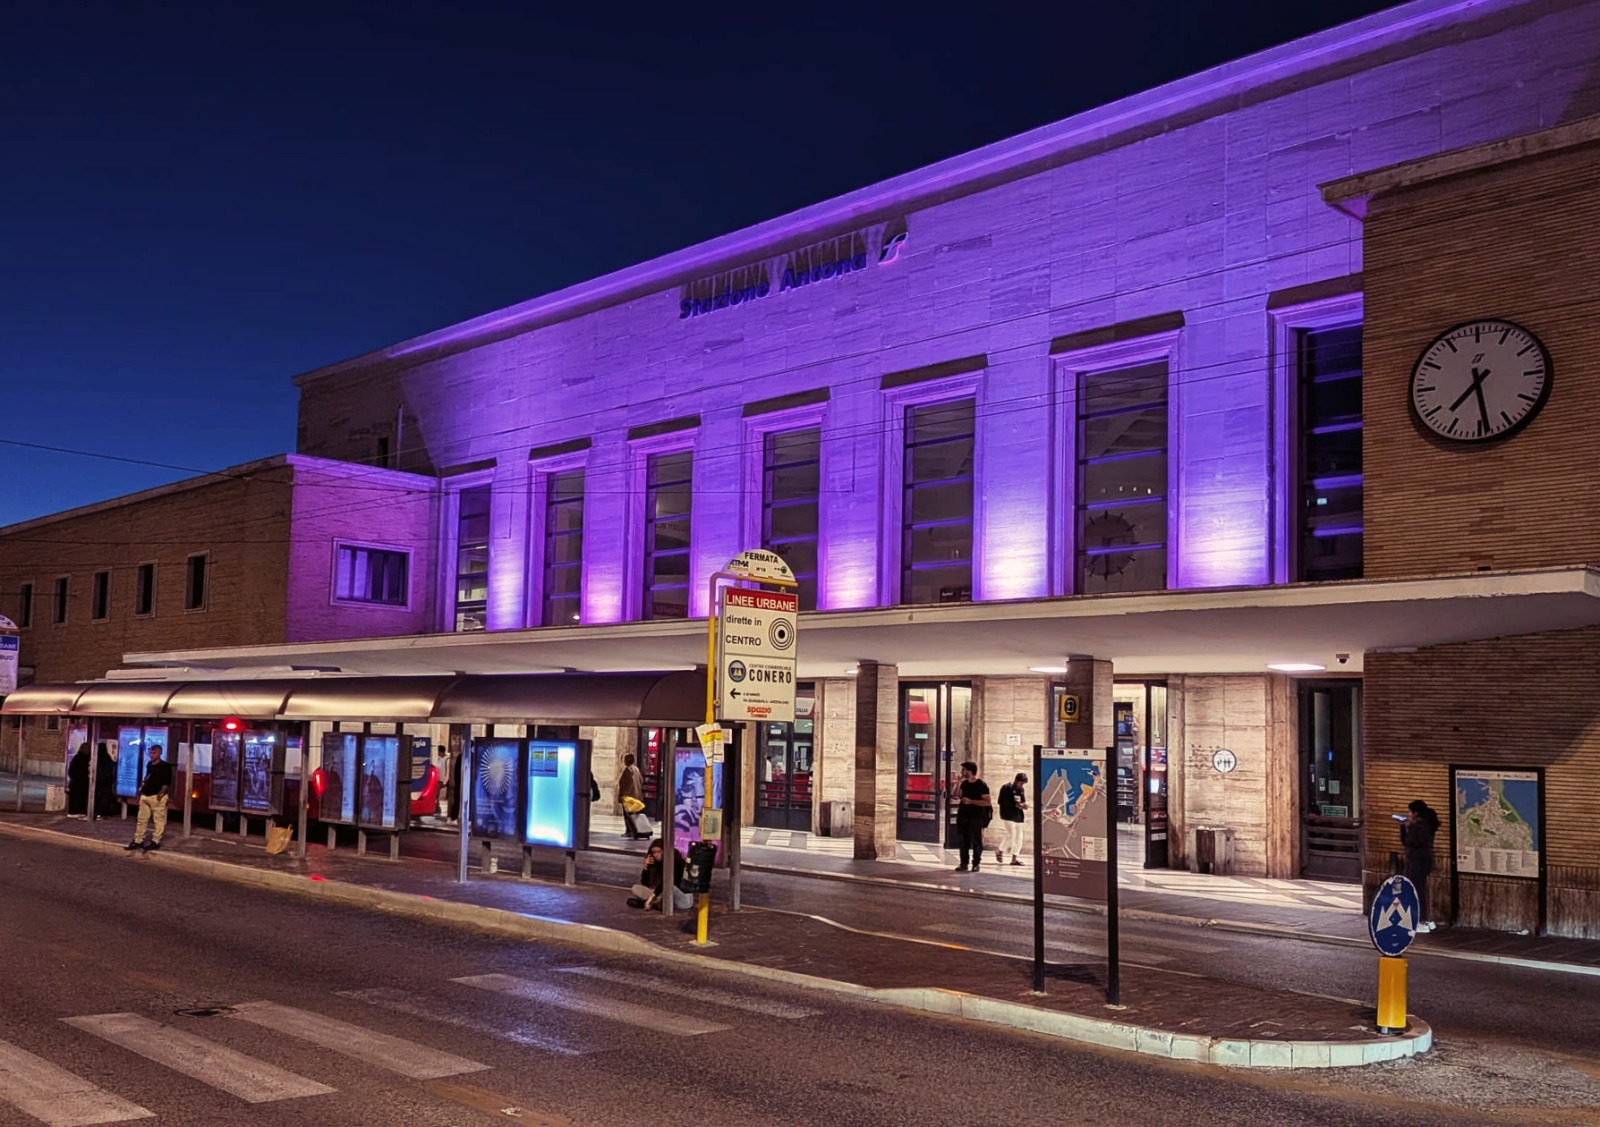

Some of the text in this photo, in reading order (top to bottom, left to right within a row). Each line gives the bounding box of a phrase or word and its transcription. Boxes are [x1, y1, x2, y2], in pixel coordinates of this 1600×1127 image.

[679, 252, 867, 319] Stazione Ancona
[744, 552, 779, 564] FERMATA
[727, 594, 796, 612] LINEE URBANE
[726, 615, 762, 626] dirette in
[725, 635, 762, 646] CENTRO
[749, 669, 792, 684] CONERO
[747, 706, 772, 714] spazio
